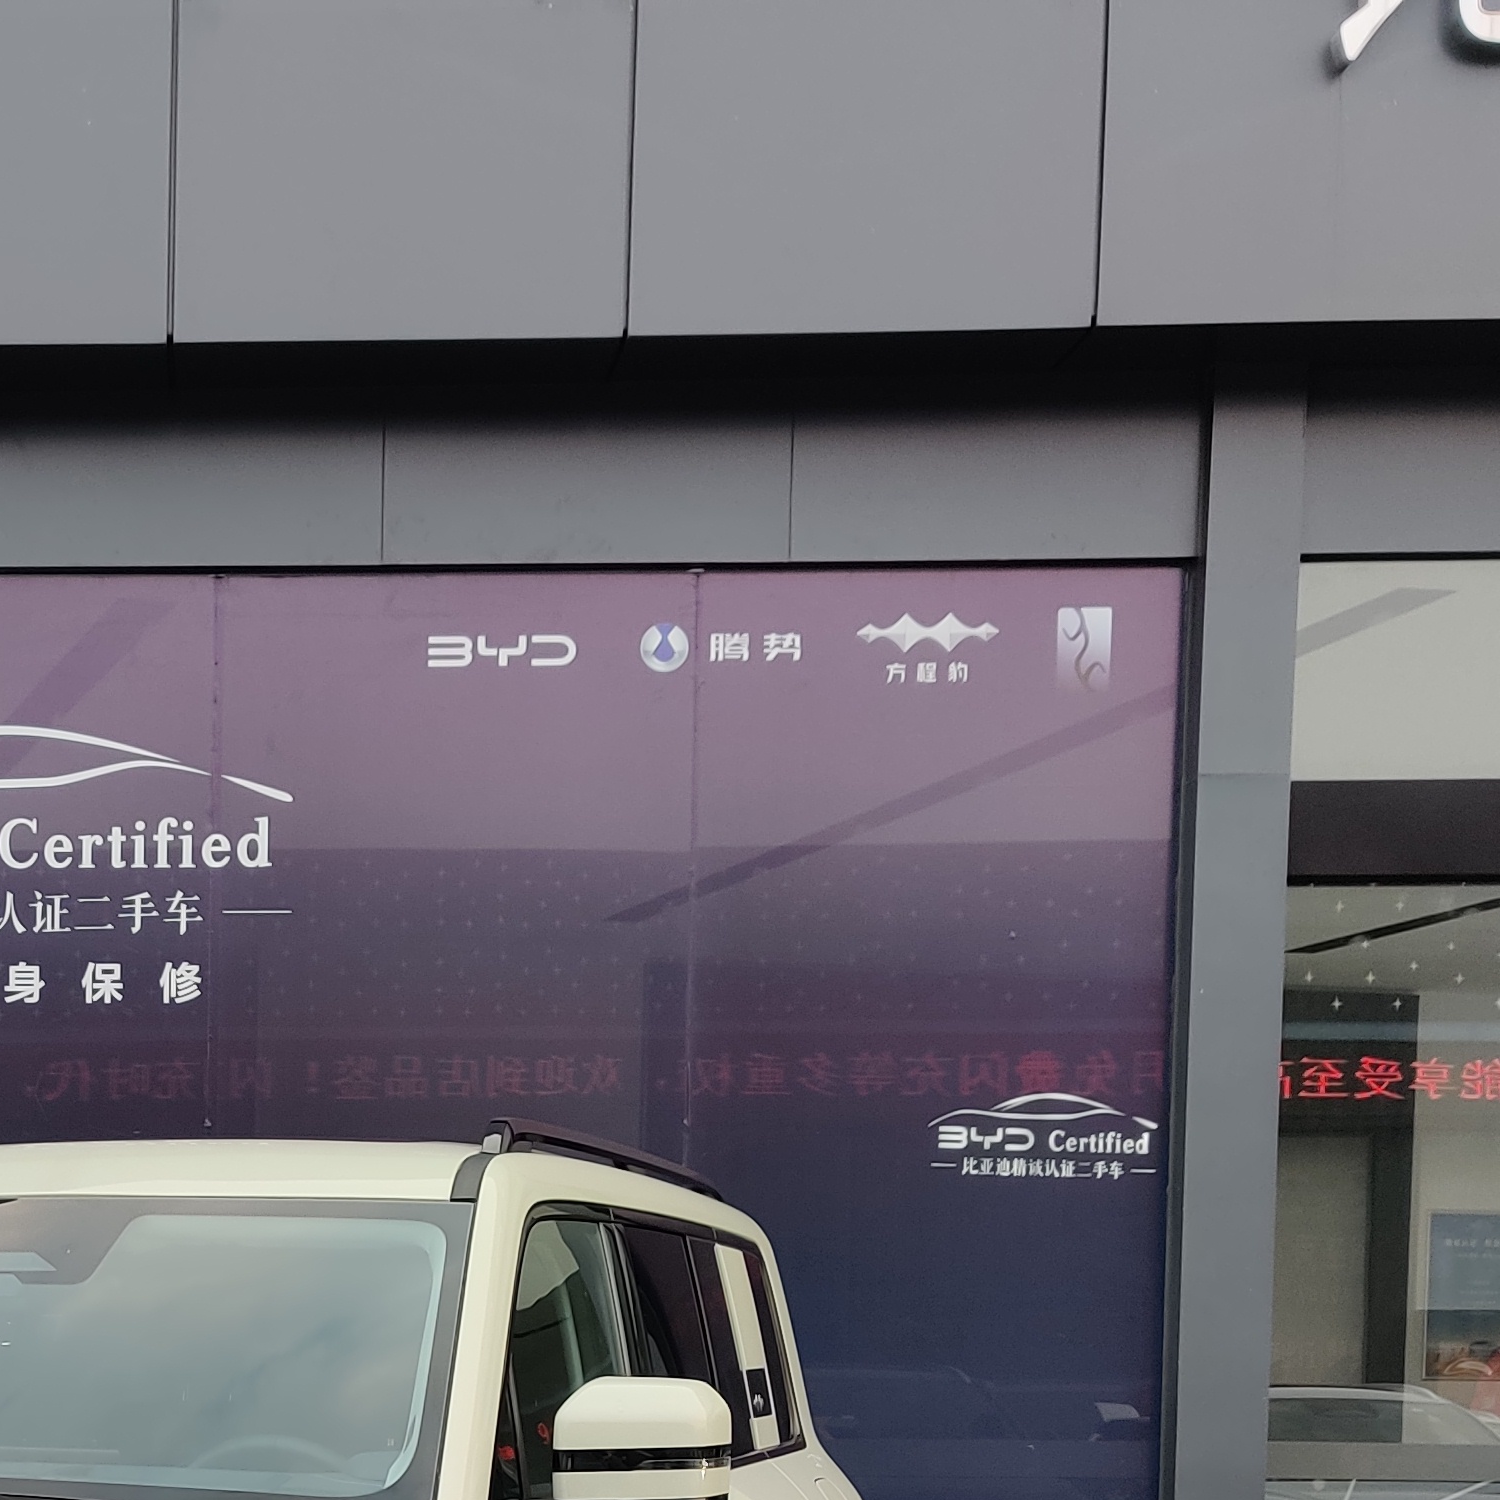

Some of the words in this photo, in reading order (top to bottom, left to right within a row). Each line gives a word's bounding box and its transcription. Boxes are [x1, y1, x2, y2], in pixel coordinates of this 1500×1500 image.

[427, 635, 577, 668] BYD
[710, 632, 802, 662] 腾势
[886, 661, 968, 684] 方程豹
[937, 1125, 1035, 1151] BYD
[1048, 1129, 1150, 1155] Certified
[961, 1156, 1125, 1180] 比亚迪精诚认证二手车
